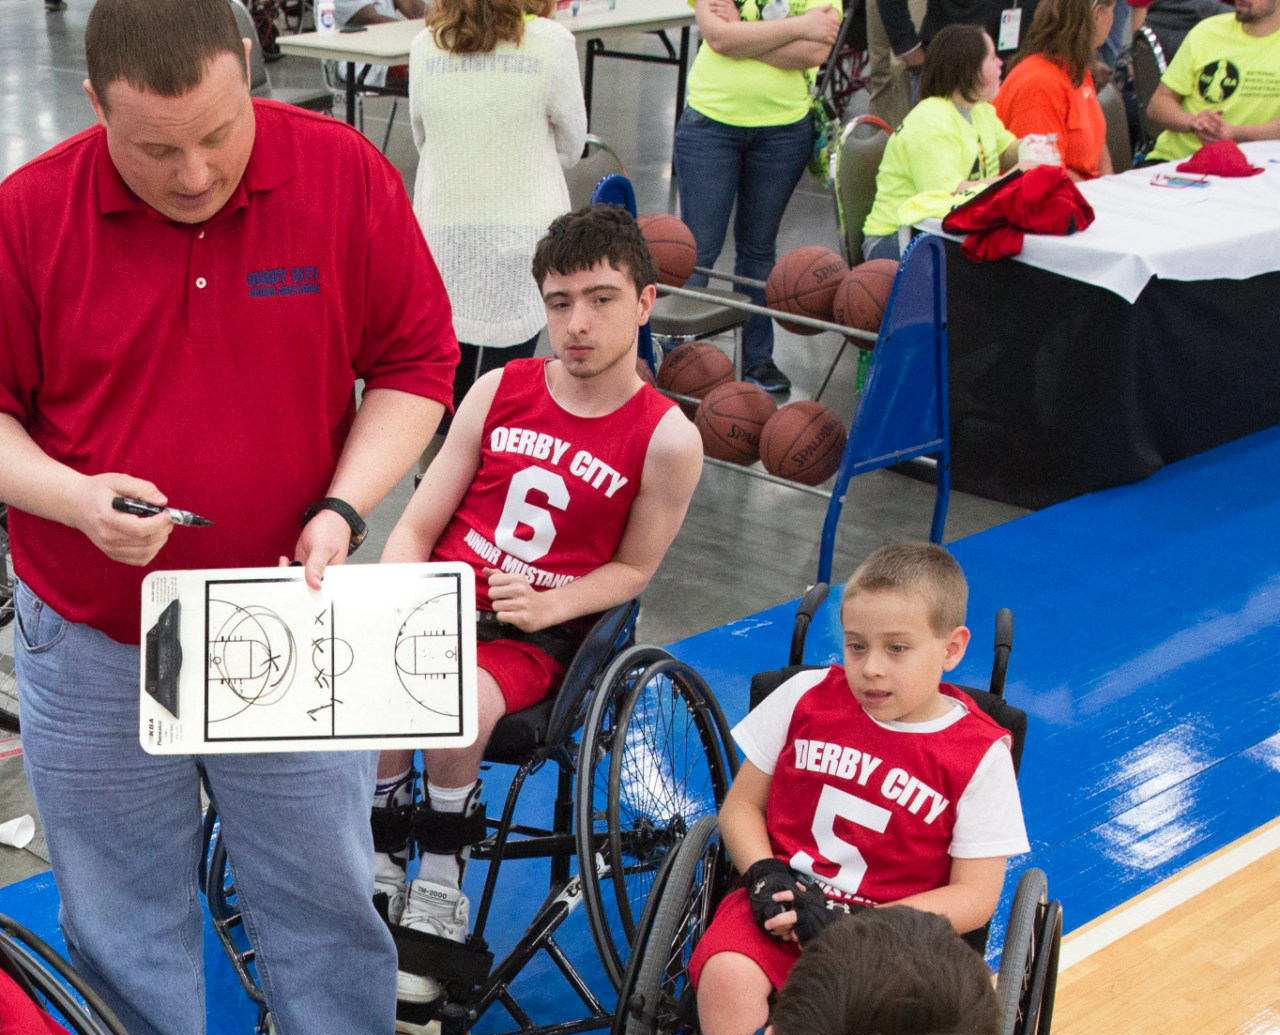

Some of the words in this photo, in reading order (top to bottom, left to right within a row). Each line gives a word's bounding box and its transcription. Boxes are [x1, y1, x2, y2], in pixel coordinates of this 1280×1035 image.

[490, 426, 571, 466] DERBY
[569, 450, 629, 499] CITY
[727, 424, 760, 447] SPAL
[494, 465, 571, 563] 6
[463, 528, 499, 565] JUNIOR
[500, 555, 583, 589] MUSTANG
[794, 738, 883, 787] DERBY
[880, 767, 951, 825] CITY
[789, 783, 893, 895] 5
[418, 885, 448, 900] TM-2000
